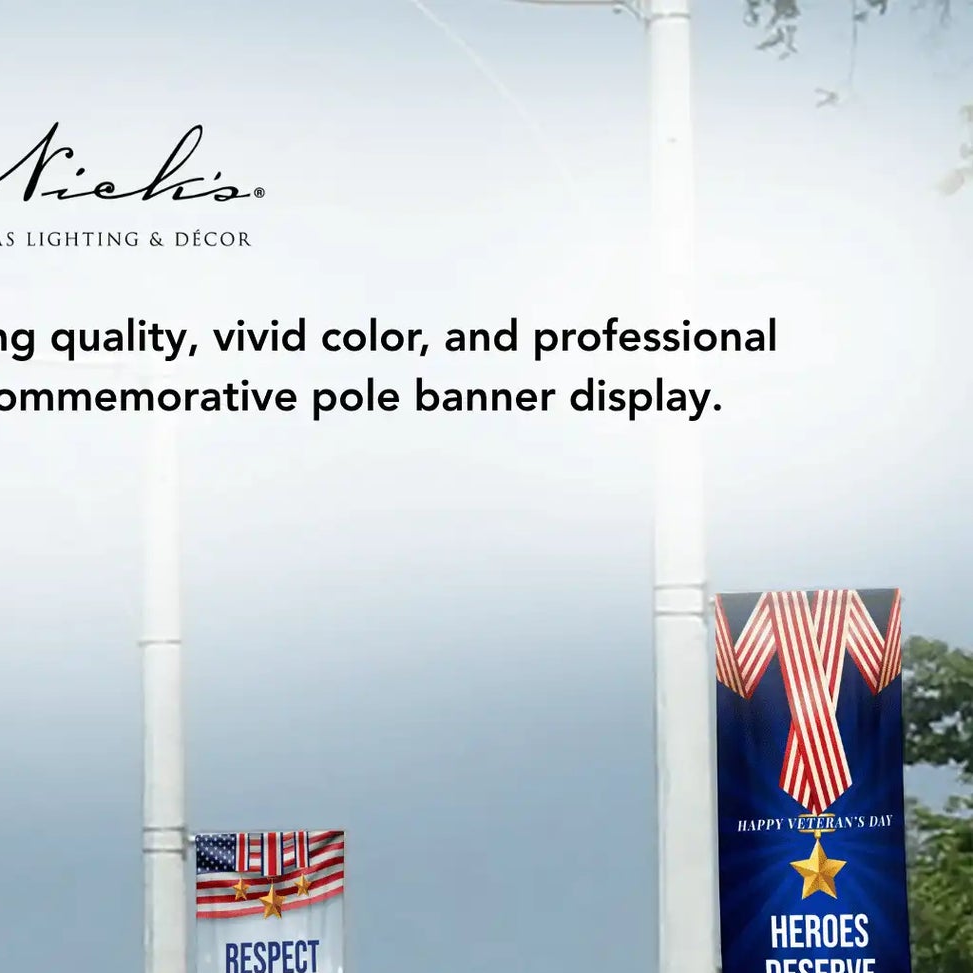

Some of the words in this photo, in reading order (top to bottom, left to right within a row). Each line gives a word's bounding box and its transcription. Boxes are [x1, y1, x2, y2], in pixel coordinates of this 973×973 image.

[737, 817, 784, 832] HAPPY
[788, 815, 865, 830] VETERAN'S
[869, 814, 894, 828] DAY
[770, 913, 870, 948] HEROES
